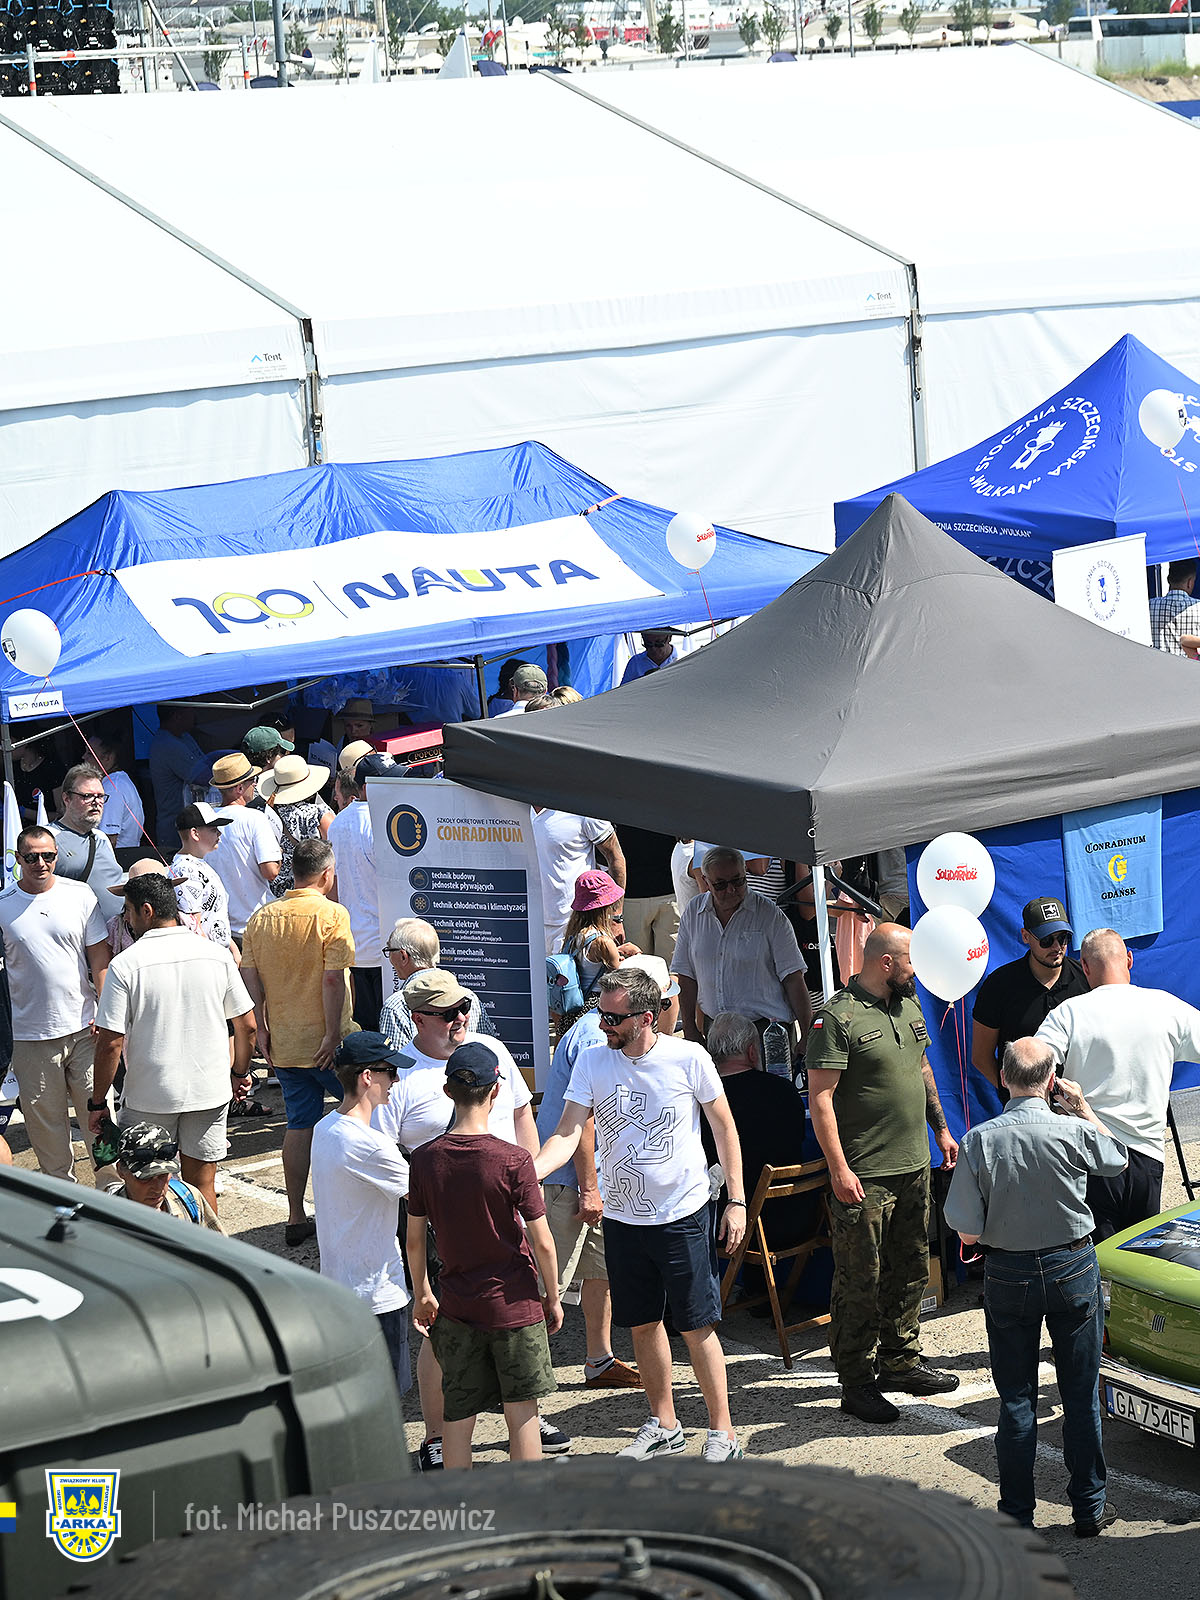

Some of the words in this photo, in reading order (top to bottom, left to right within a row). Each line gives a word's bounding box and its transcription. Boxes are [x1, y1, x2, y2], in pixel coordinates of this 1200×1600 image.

[263, 353, 282, 361] Tent
[974, 405, 1056, 472] STOCZNIA
[1047, 397, 1101, 476] SZCZECIŃSKA
[953, 522, 998, 534] SZCZECIŃSKA
[342, 559, 600, 610] NAUTA
[172, 588, 315, 634] 100
[31, 699, 60, 709] NAUTA
[456, 818, 485, 826] OKRĘTOWE
[437, 825, 524, 843] CONRADINUM
[431, 872, 452, 880] technik
[452, 872, 475, 882] budowy
[431, 881, 459, 889] jednostek
[460, 881, 495, 892] pływających
[1101, 886, 1137, 900] GDAŃSK
[453, 901, 487, 910] chłodnictwa
[490, 902, 526, 912] klimatyzacji
[434, 920, 455, 928] technik
[455, 920, 480, 929] elektryk
[440, 947, 456, 955] chnik
[456, 948, 484, 956] mechanik
[458, 973, 486, 981] mechanik
[1116, 1391, 1137, 1420] GA
[1141, 1400, 1190, 1438] 754FF
